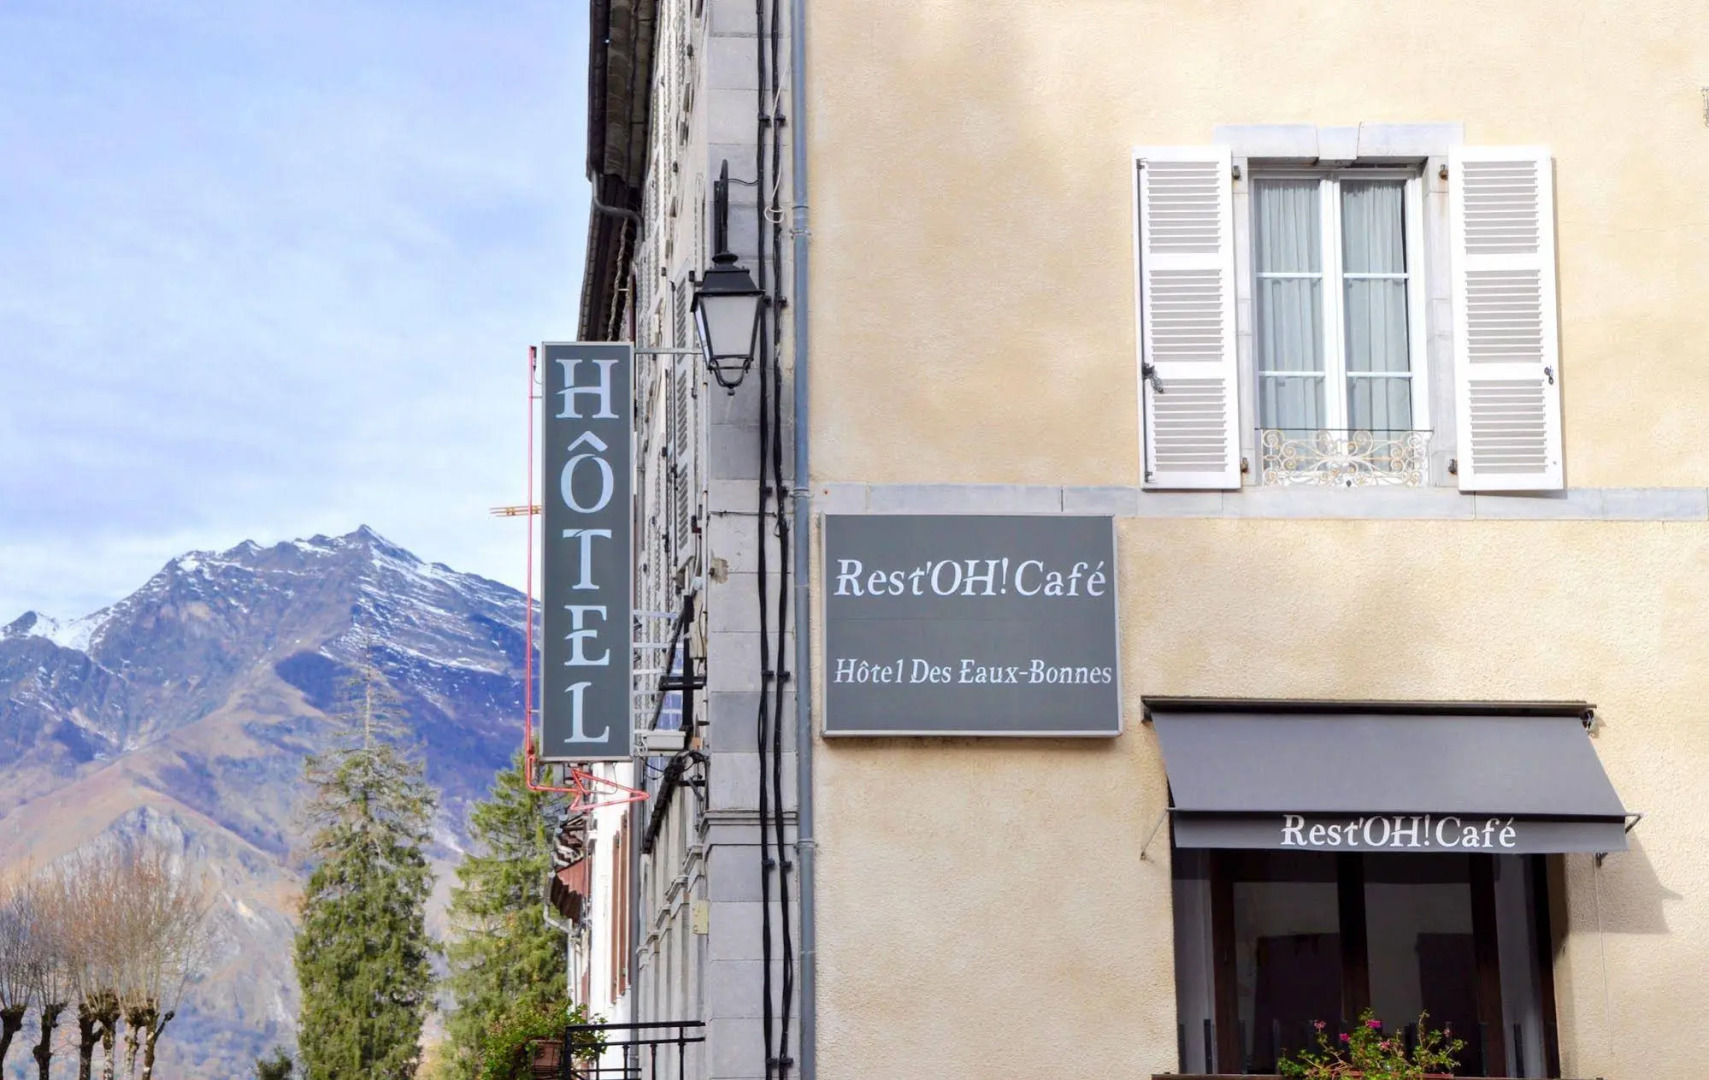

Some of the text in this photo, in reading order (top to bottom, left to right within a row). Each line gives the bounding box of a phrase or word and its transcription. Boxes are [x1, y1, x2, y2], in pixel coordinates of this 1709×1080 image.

[555, 358, 620, 743] HÔTEL
[833, 658, 1112, 684] Hôtel Des Eaux-Bonnes
